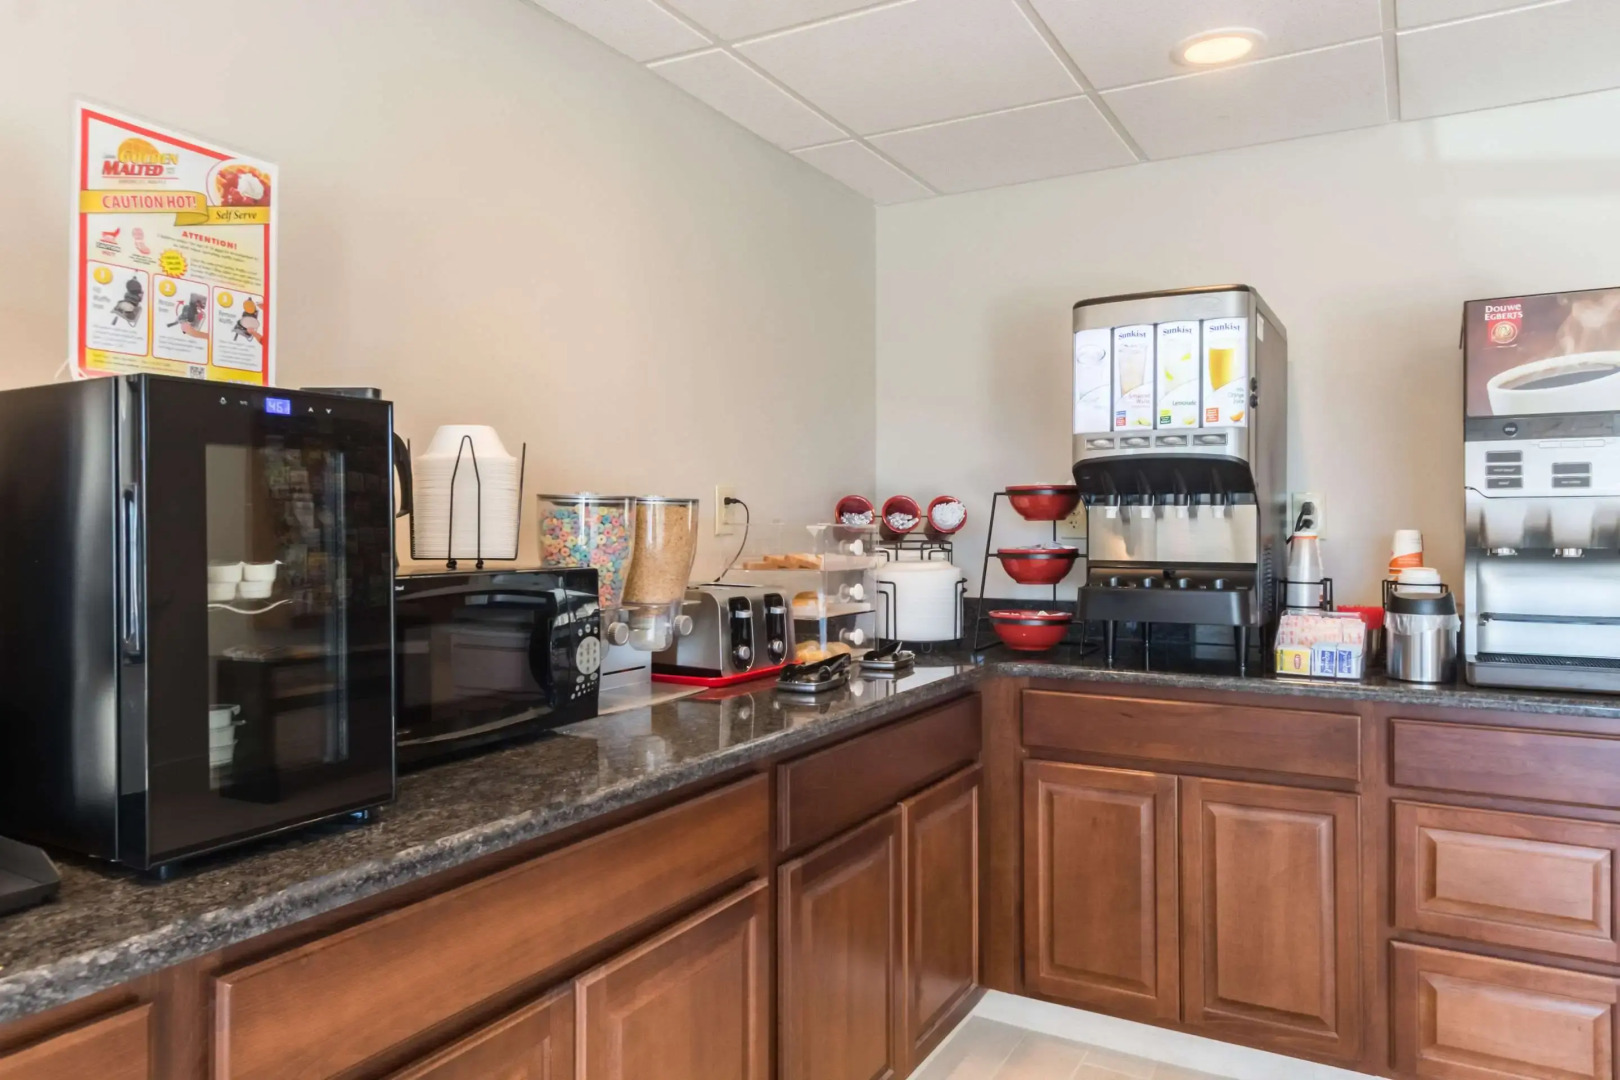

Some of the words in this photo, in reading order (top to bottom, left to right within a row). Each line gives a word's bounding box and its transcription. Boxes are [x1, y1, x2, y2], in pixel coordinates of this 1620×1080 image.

[119, 150, 179, 165] GOLDEN
[102, 160, 165, 177] MALTED
[102, 195, 164, 209] CAUTION
[167, 195, 197, 209] HOT!
[215, 210, 232, 222] Self
[234, 210, 258, 220] Serve
[181, 230, 238, 250] ATTENTION!
[1484, 311, 1523, 321] EGBERTS
[1162, 326, 1192, 336] Sunkist
[1209, 322, 1240, 332] Sunkist
[1118, 330, 1147, 340] Sunkist
[1228, 391, 1245, 399] Orange
